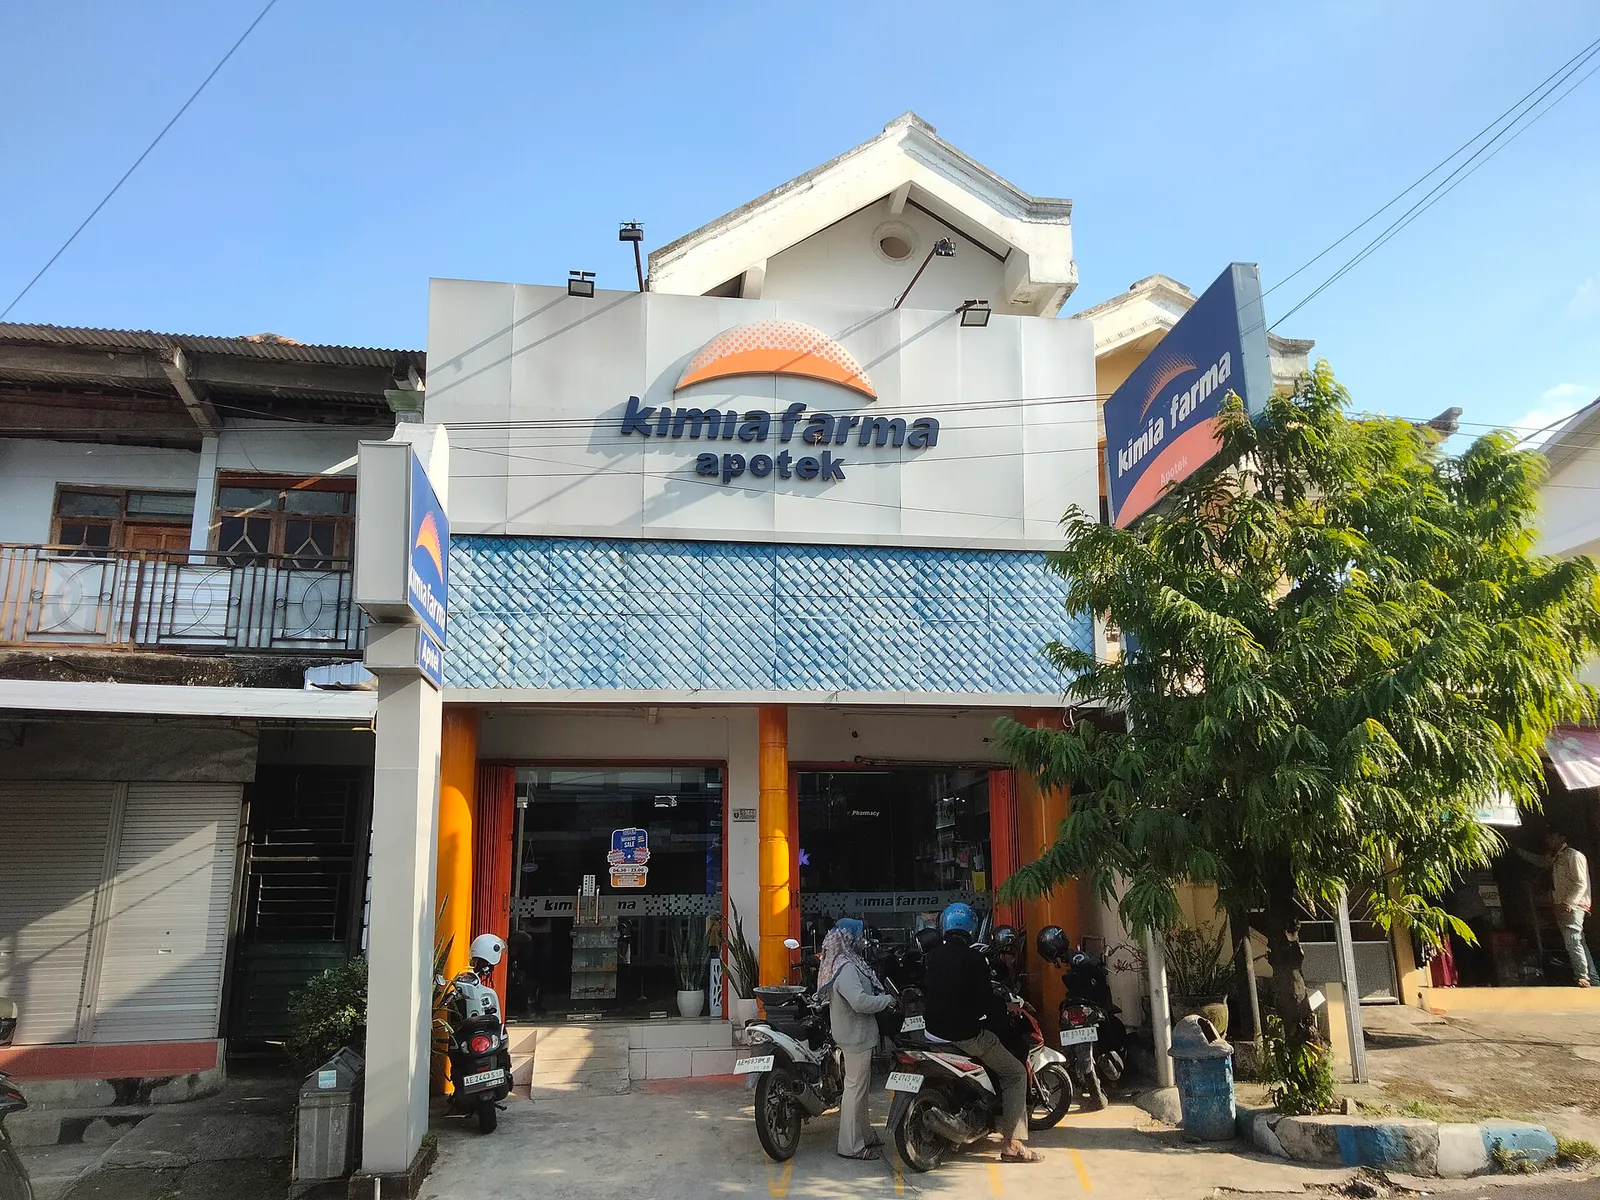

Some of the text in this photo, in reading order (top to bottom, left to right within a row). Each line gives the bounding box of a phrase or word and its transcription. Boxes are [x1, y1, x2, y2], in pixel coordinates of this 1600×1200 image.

[620, 396, 940, 449] kimia farma
[1118, 351, 1231, 478] kimia farma
[695, 449, 847, 484] apotek
[1160, 455, 1188, 486] Apotek
[851, 809, 880, 818] Pharmacy
[855, 895, 940, 907] kimia farma
